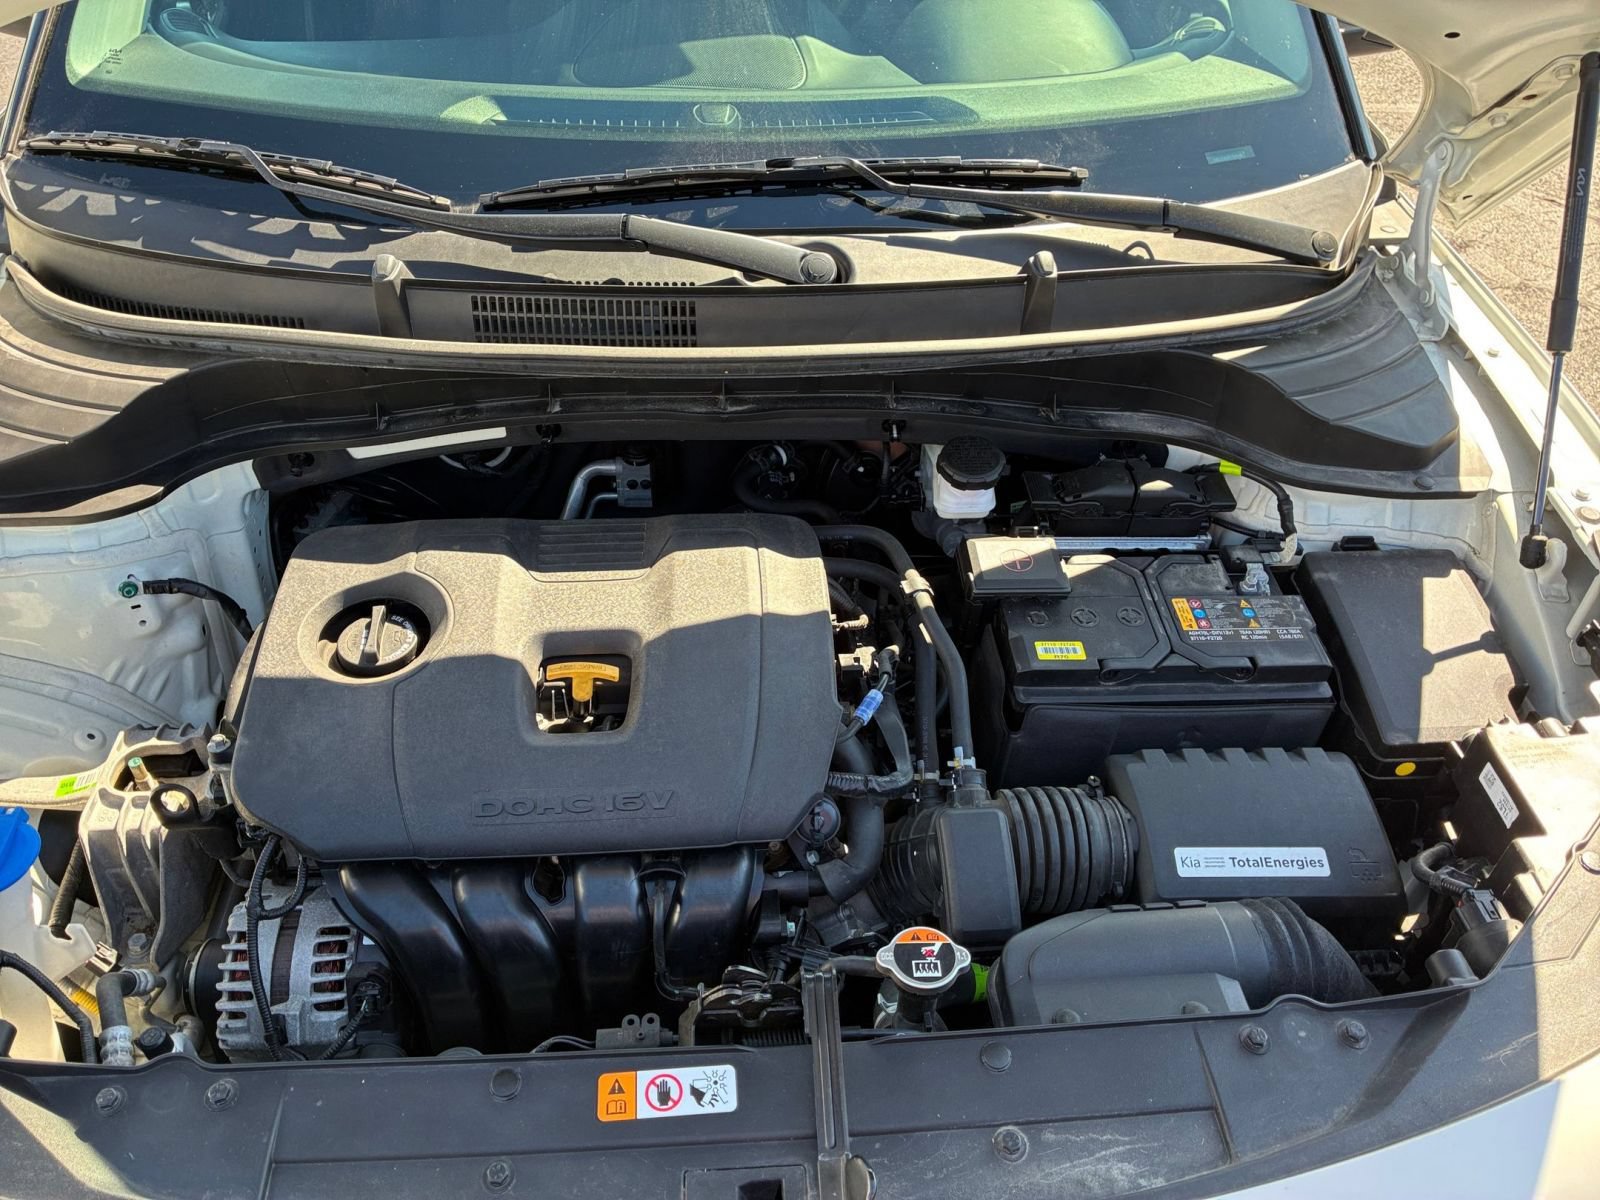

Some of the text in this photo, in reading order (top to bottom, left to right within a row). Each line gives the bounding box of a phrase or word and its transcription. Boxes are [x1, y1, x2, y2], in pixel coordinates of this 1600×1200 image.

[474, 789, 674, 818] DOHC 16V
[1180, 856, 1201, 868] Kia
[1229, 856, 1325, 870] TotalEnergies
